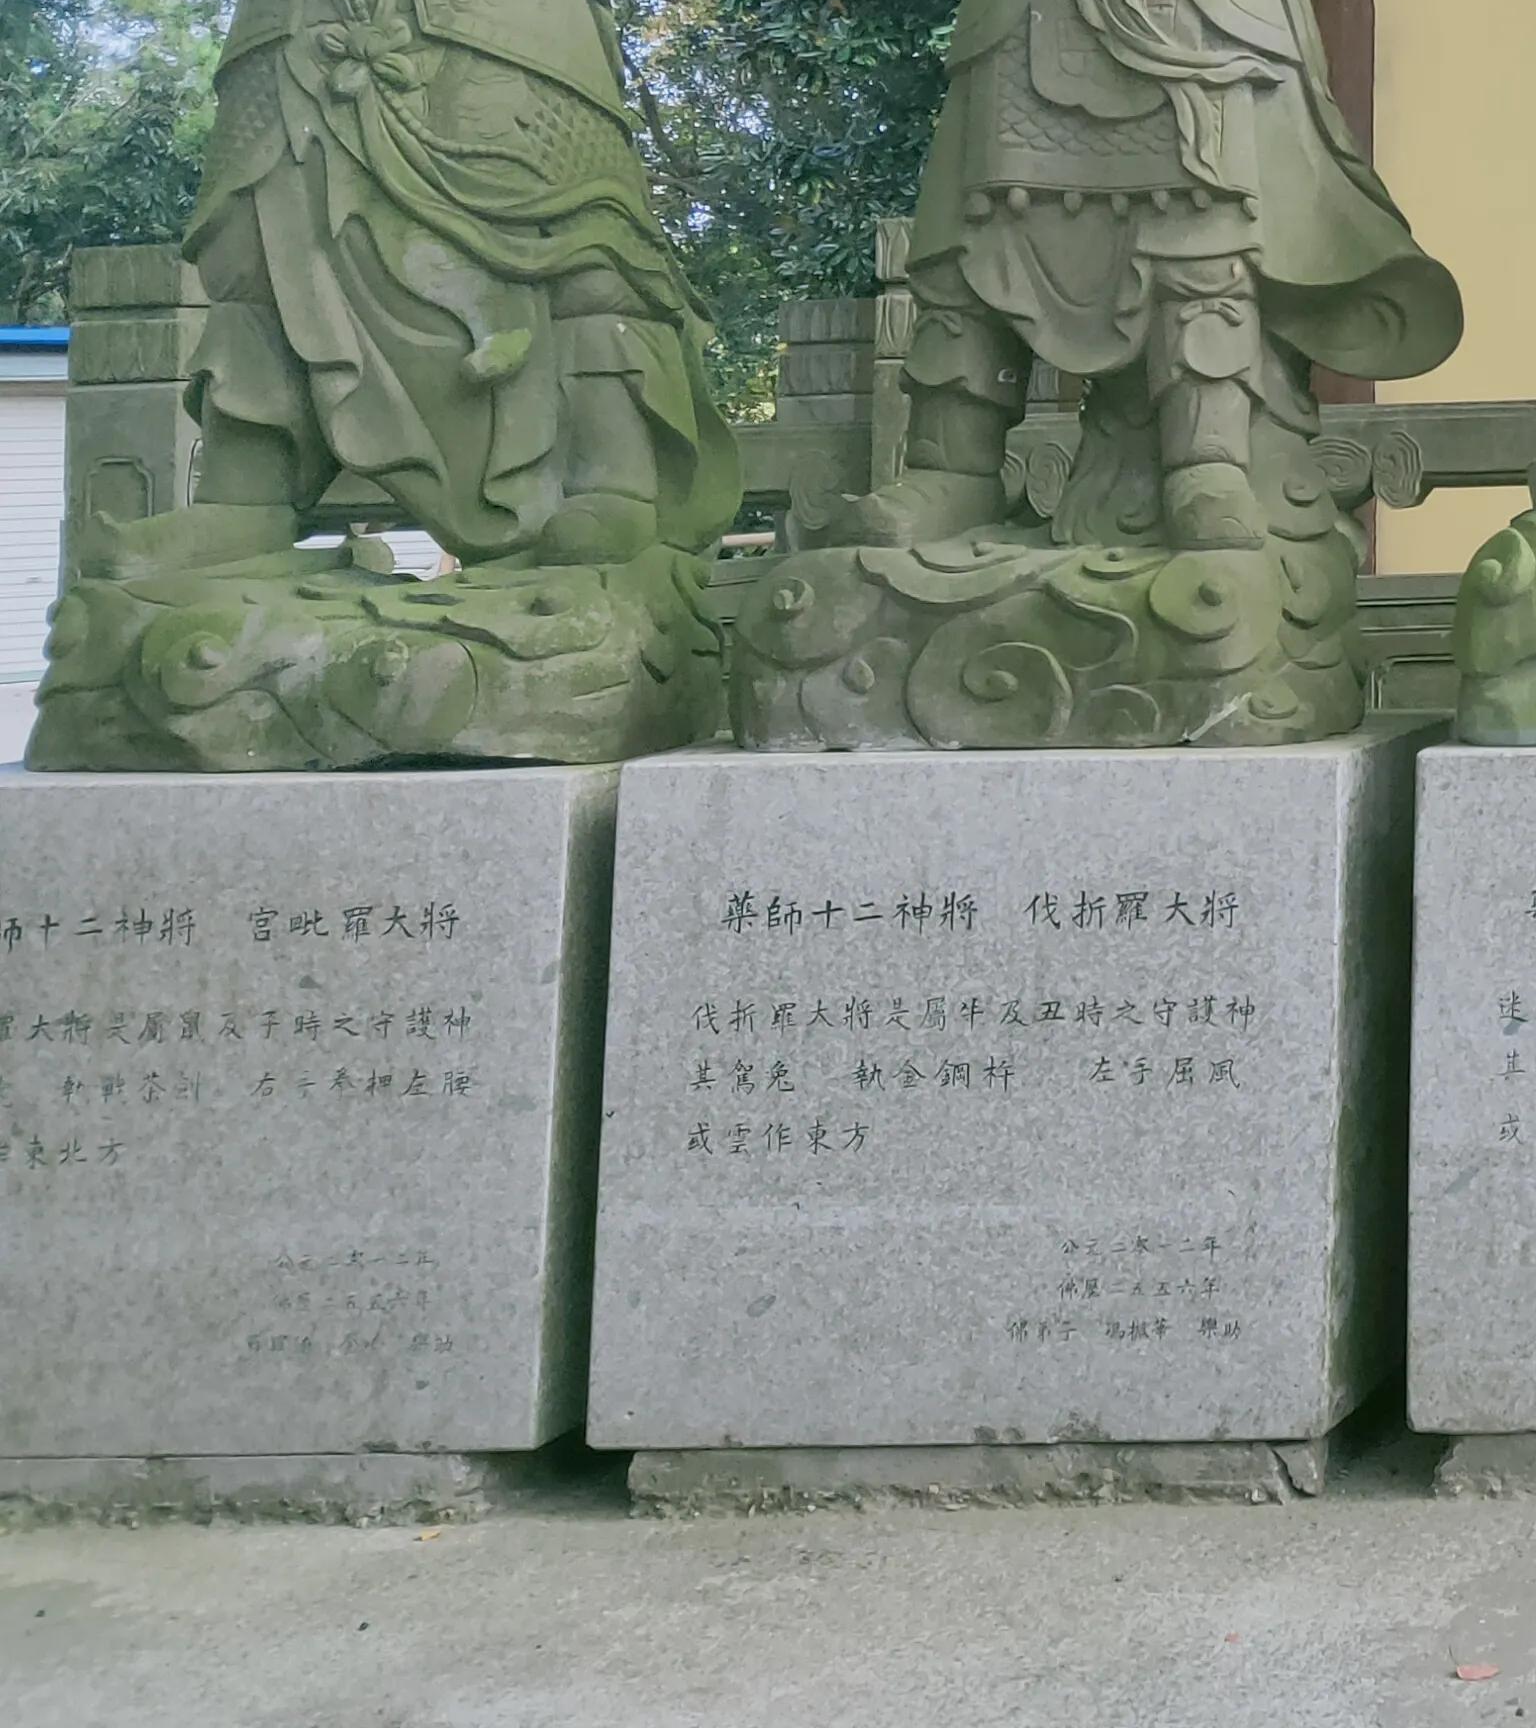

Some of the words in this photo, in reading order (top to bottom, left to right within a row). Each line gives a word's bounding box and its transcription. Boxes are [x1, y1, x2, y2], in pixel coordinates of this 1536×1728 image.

[721, 889, 978, 935] 藥師十二神將
[1023, 889, 1240, 931] 伐折羅大將
[687, 1119, 869, 1156] 或雲作東方
